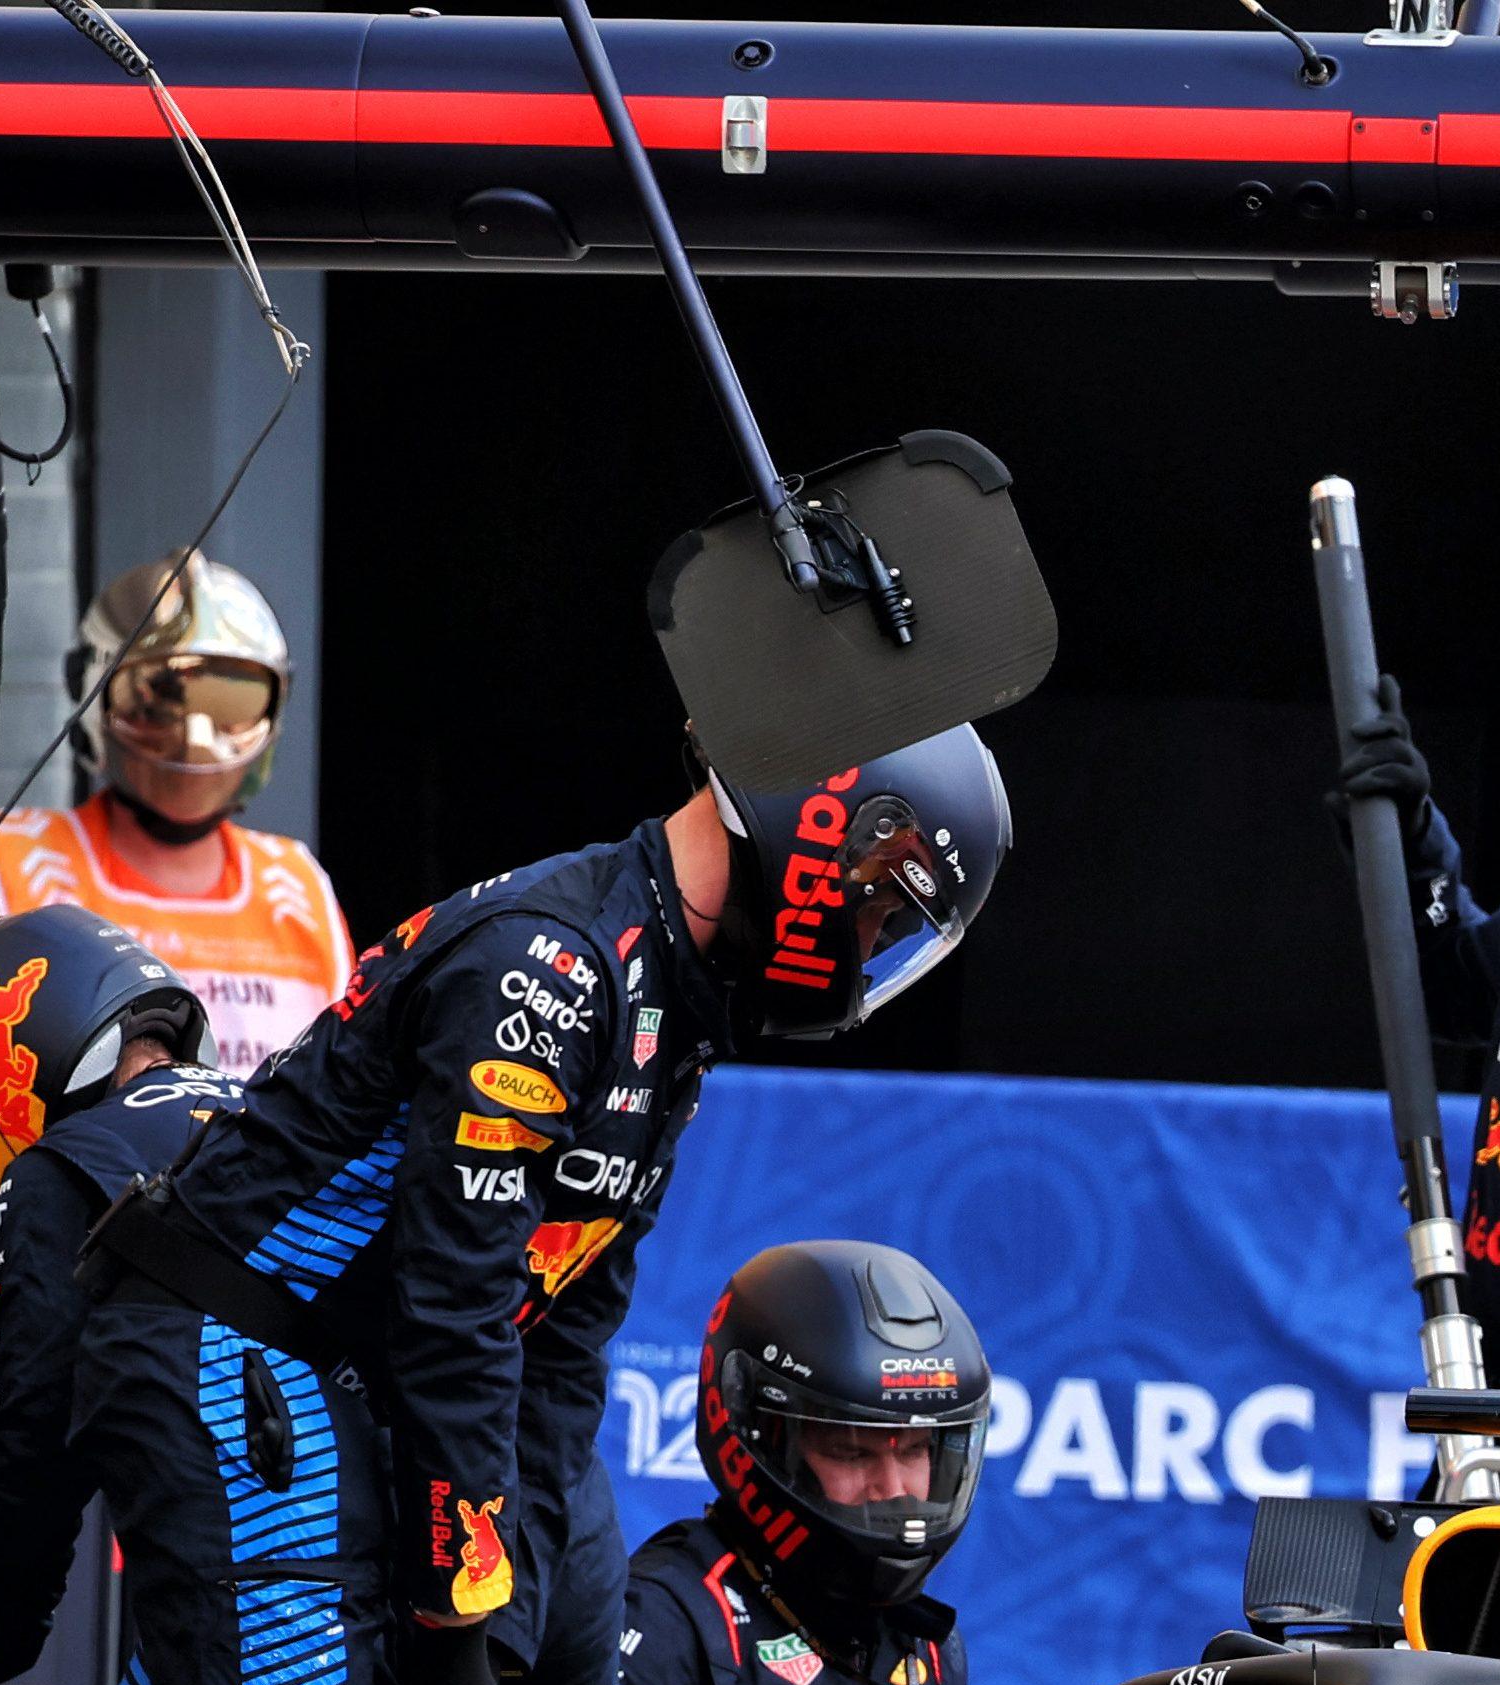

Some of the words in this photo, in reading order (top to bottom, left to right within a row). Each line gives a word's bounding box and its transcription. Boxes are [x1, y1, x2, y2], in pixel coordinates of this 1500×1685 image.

[905, 862, 933, 893] HJC
[765, 853, 845, 990] Bull
[500, 969, 580, 1031] Claro
[494, 1073, 557, 1108] RAUCH
[453, 1165, 526, 1201] VISA
[880, 1357, 957, 1374] ORACLE
[881, 1390, 958, 1400] RACING
[429, 1480, 451, 1527] Red
[718, 1432, 810, 1560] Bull
[431, 1528, 453, 1568] Bull
[760, 1637, 811, 1662] TAG
